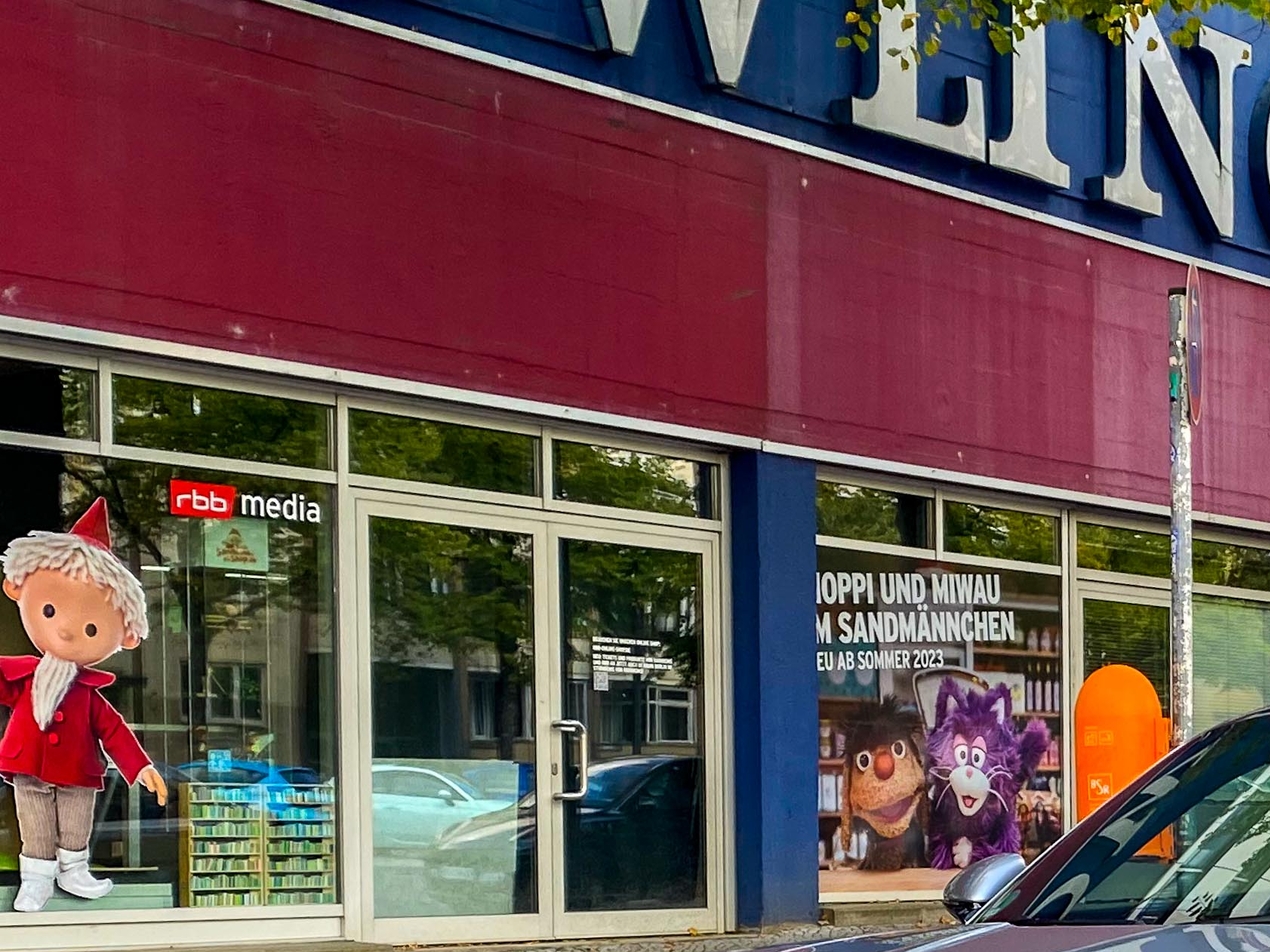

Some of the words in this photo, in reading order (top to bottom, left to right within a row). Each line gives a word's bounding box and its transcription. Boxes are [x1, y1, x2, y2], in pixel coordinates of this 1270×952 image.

[176, 489, 227, 513] rbb
[240, 493, 321, 523] media
[879, 573, 926, 604] UND
[931, 574, 1001, 604] MIWAU
[838, 604, 1015, 643] SANDMÄNNCHEN
[817, 651, 833, 671] EU
[837, 651, 854, 671] AB
[857, 650, 911, 670] SOMMER
[913, 648, 944, 668] 2023
